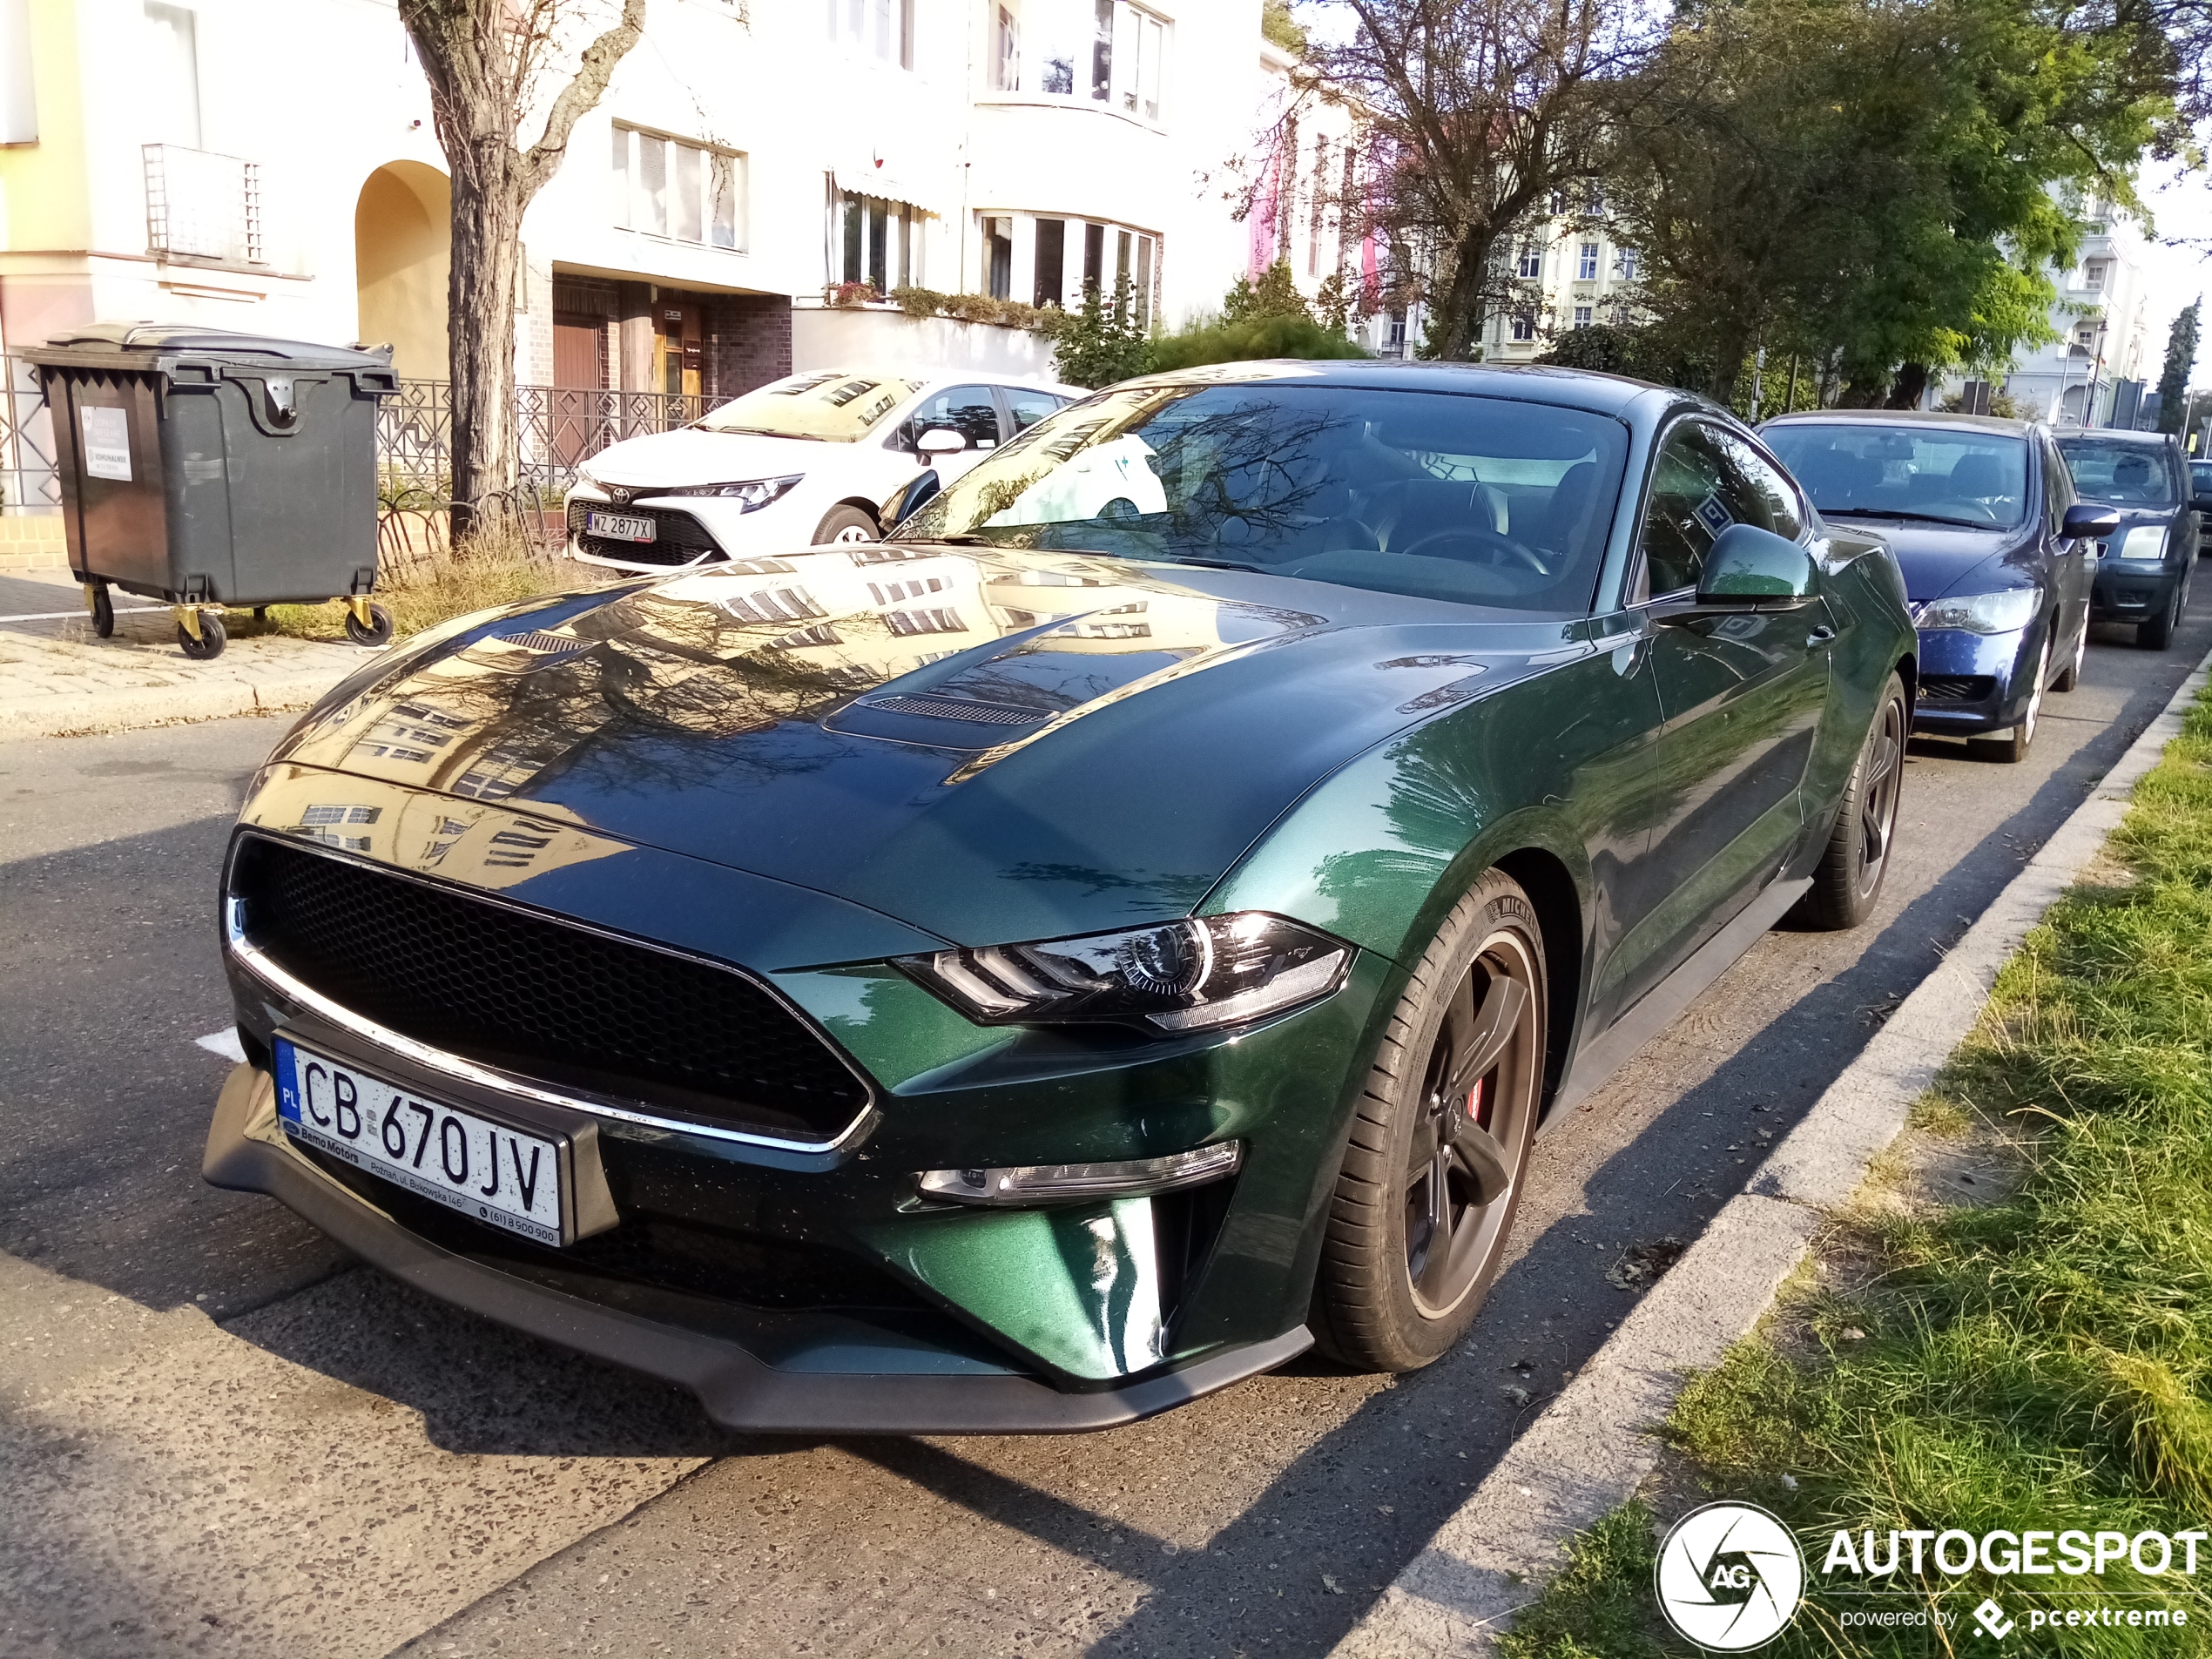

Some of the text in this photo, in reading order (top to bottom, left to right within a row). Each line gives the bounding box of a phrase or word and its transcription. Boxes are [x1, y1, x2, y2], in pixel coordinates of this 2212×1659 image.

[594, 516, 607, 532] WZ
[611, 518, 648, 537] 2877X
[283, 1087, 298, 1109] PL
[301, 1127, 359, 1164] Bemo Motors
[305, 1062, 541, 1212] CB 670JV
[410, 1177, 447, 1203] Bukowska
[448, 1194, 462, 1208] 146
[489, 1211, 507, 1225] (61)
